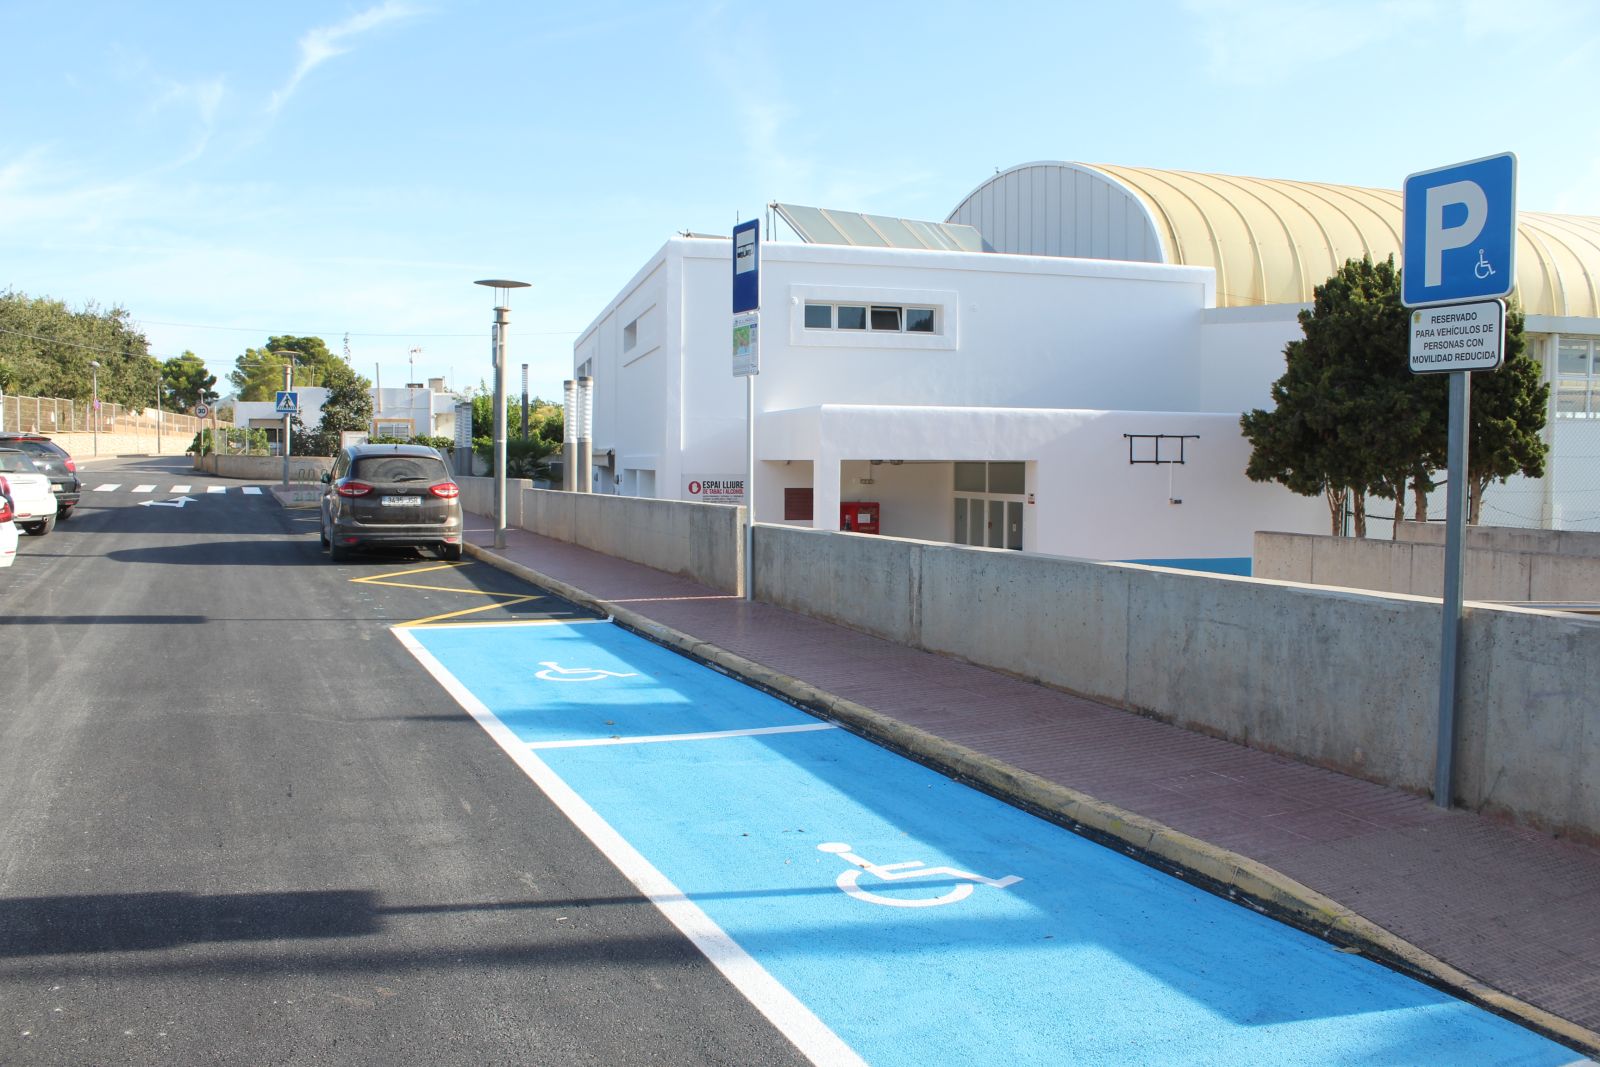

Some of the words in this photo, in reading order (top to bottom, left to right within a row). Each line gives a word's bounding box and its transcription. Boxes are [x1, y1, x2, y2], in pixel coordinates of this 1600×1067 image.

[1425, 180, 1488, 287] P
[1431, 312, 1477, 324] RESERVADO
[1416, 329, 1435, 338] PARA
[1437, 325, 1480, 336] VEHÍCULOS
[1483, 324, 1494, 333] DE
[1424, 340, 1464, 350] PERSONAS
[1466, 339, 1484, 347] CON
[1412, 354, 1453, 364] MOVILIDAD
[1455, 351, 1496, 361] REDUCIDA
[702, 480, 721, 489] ESPAI
[722, 480, 744, 489] LLIURE
